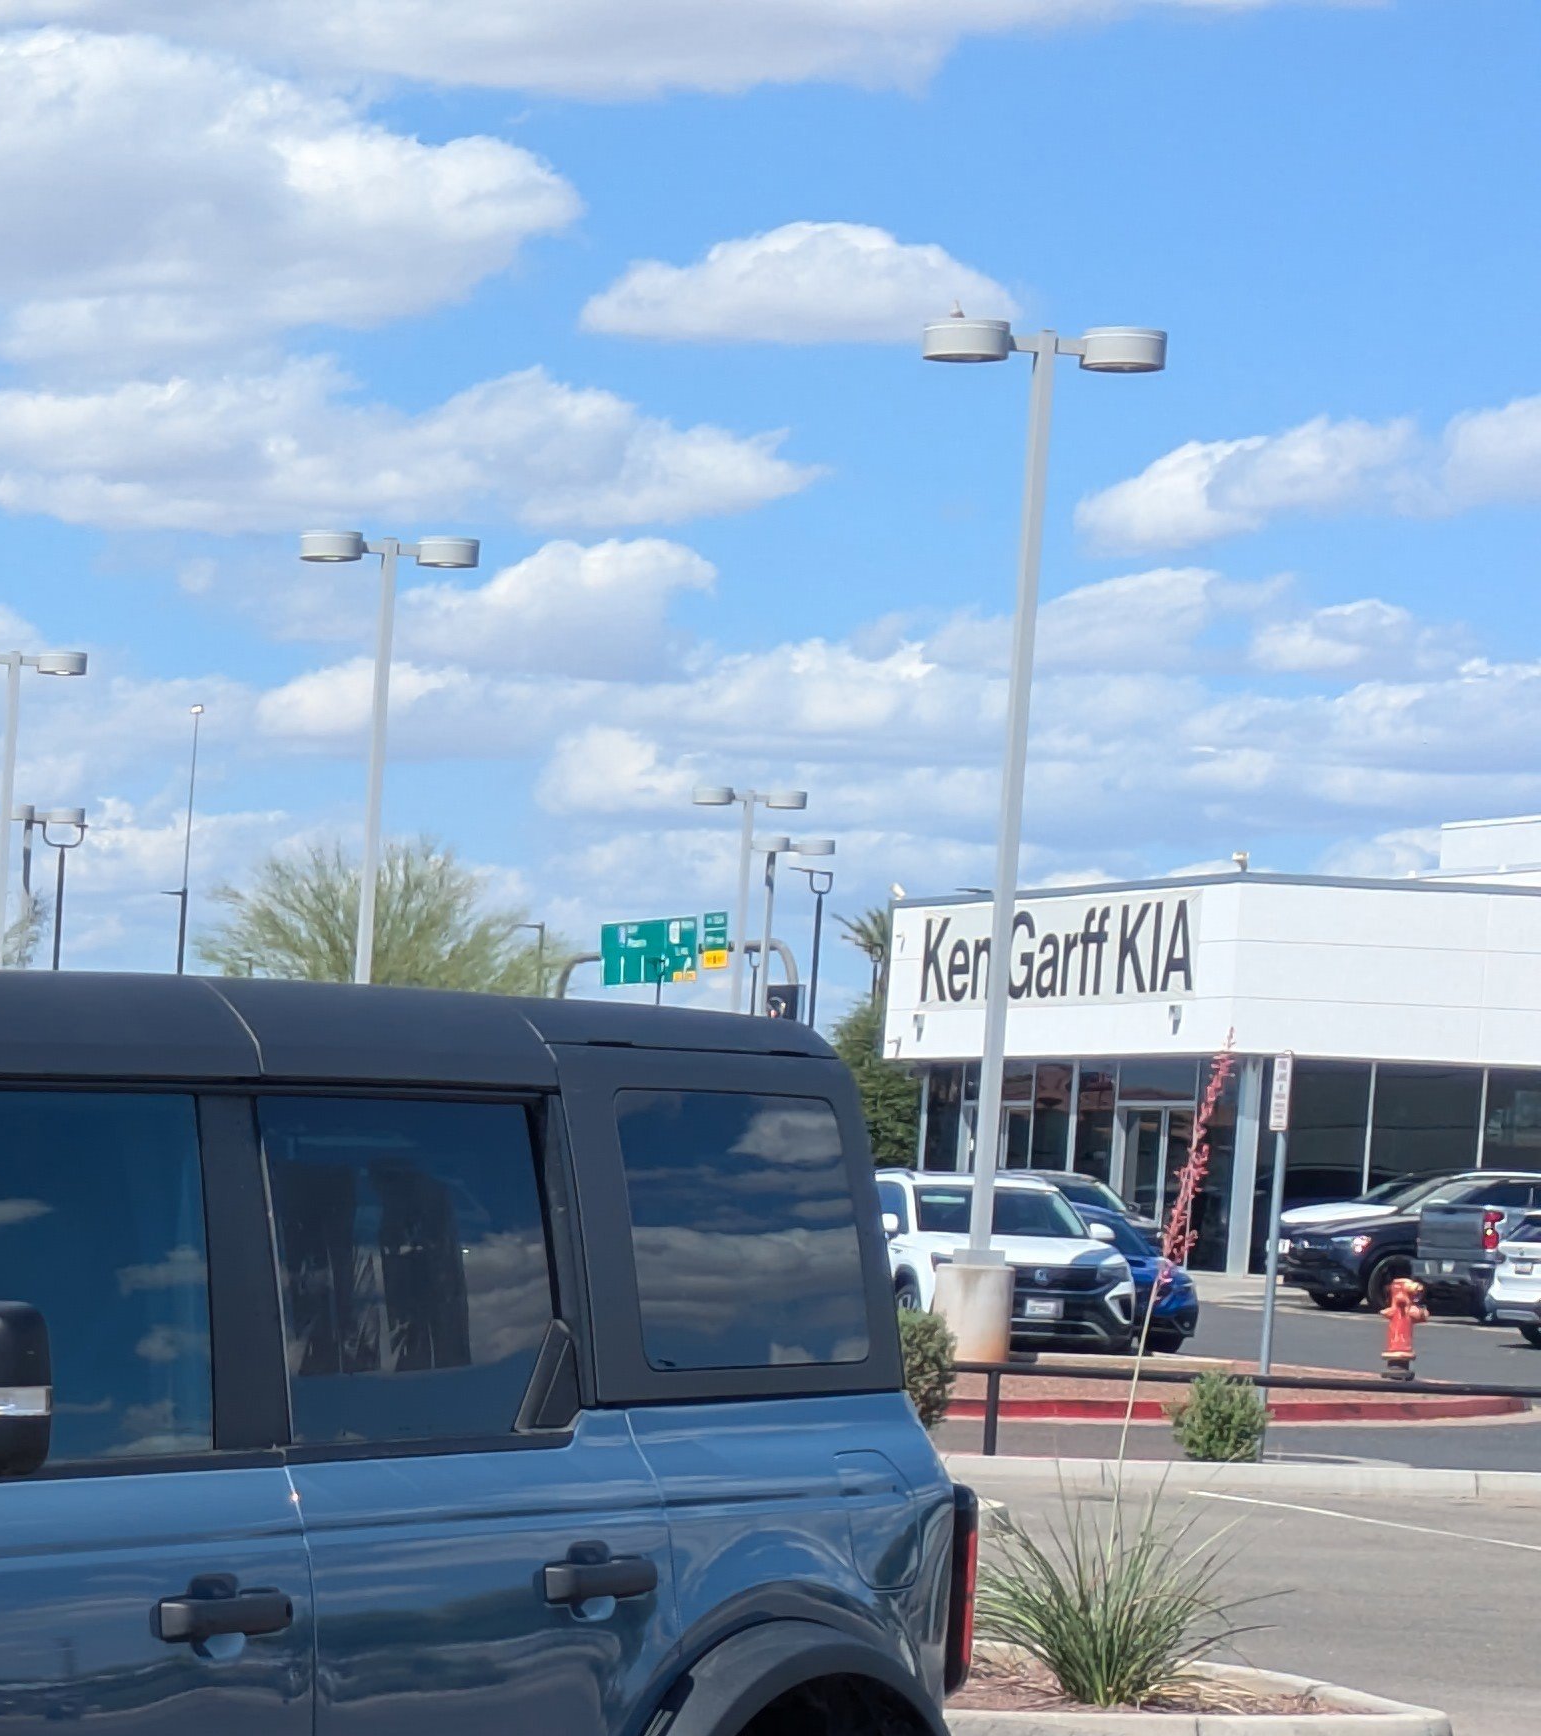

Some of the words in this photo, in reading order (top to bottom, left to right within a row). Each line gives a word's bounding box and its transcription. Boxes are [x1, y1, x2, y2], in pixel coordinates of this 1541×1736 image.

[920, 917, 991, 1002] Ken
[1009, 906, 1111, 998] Garff
[1116, 900, 1193, 994] KIA
